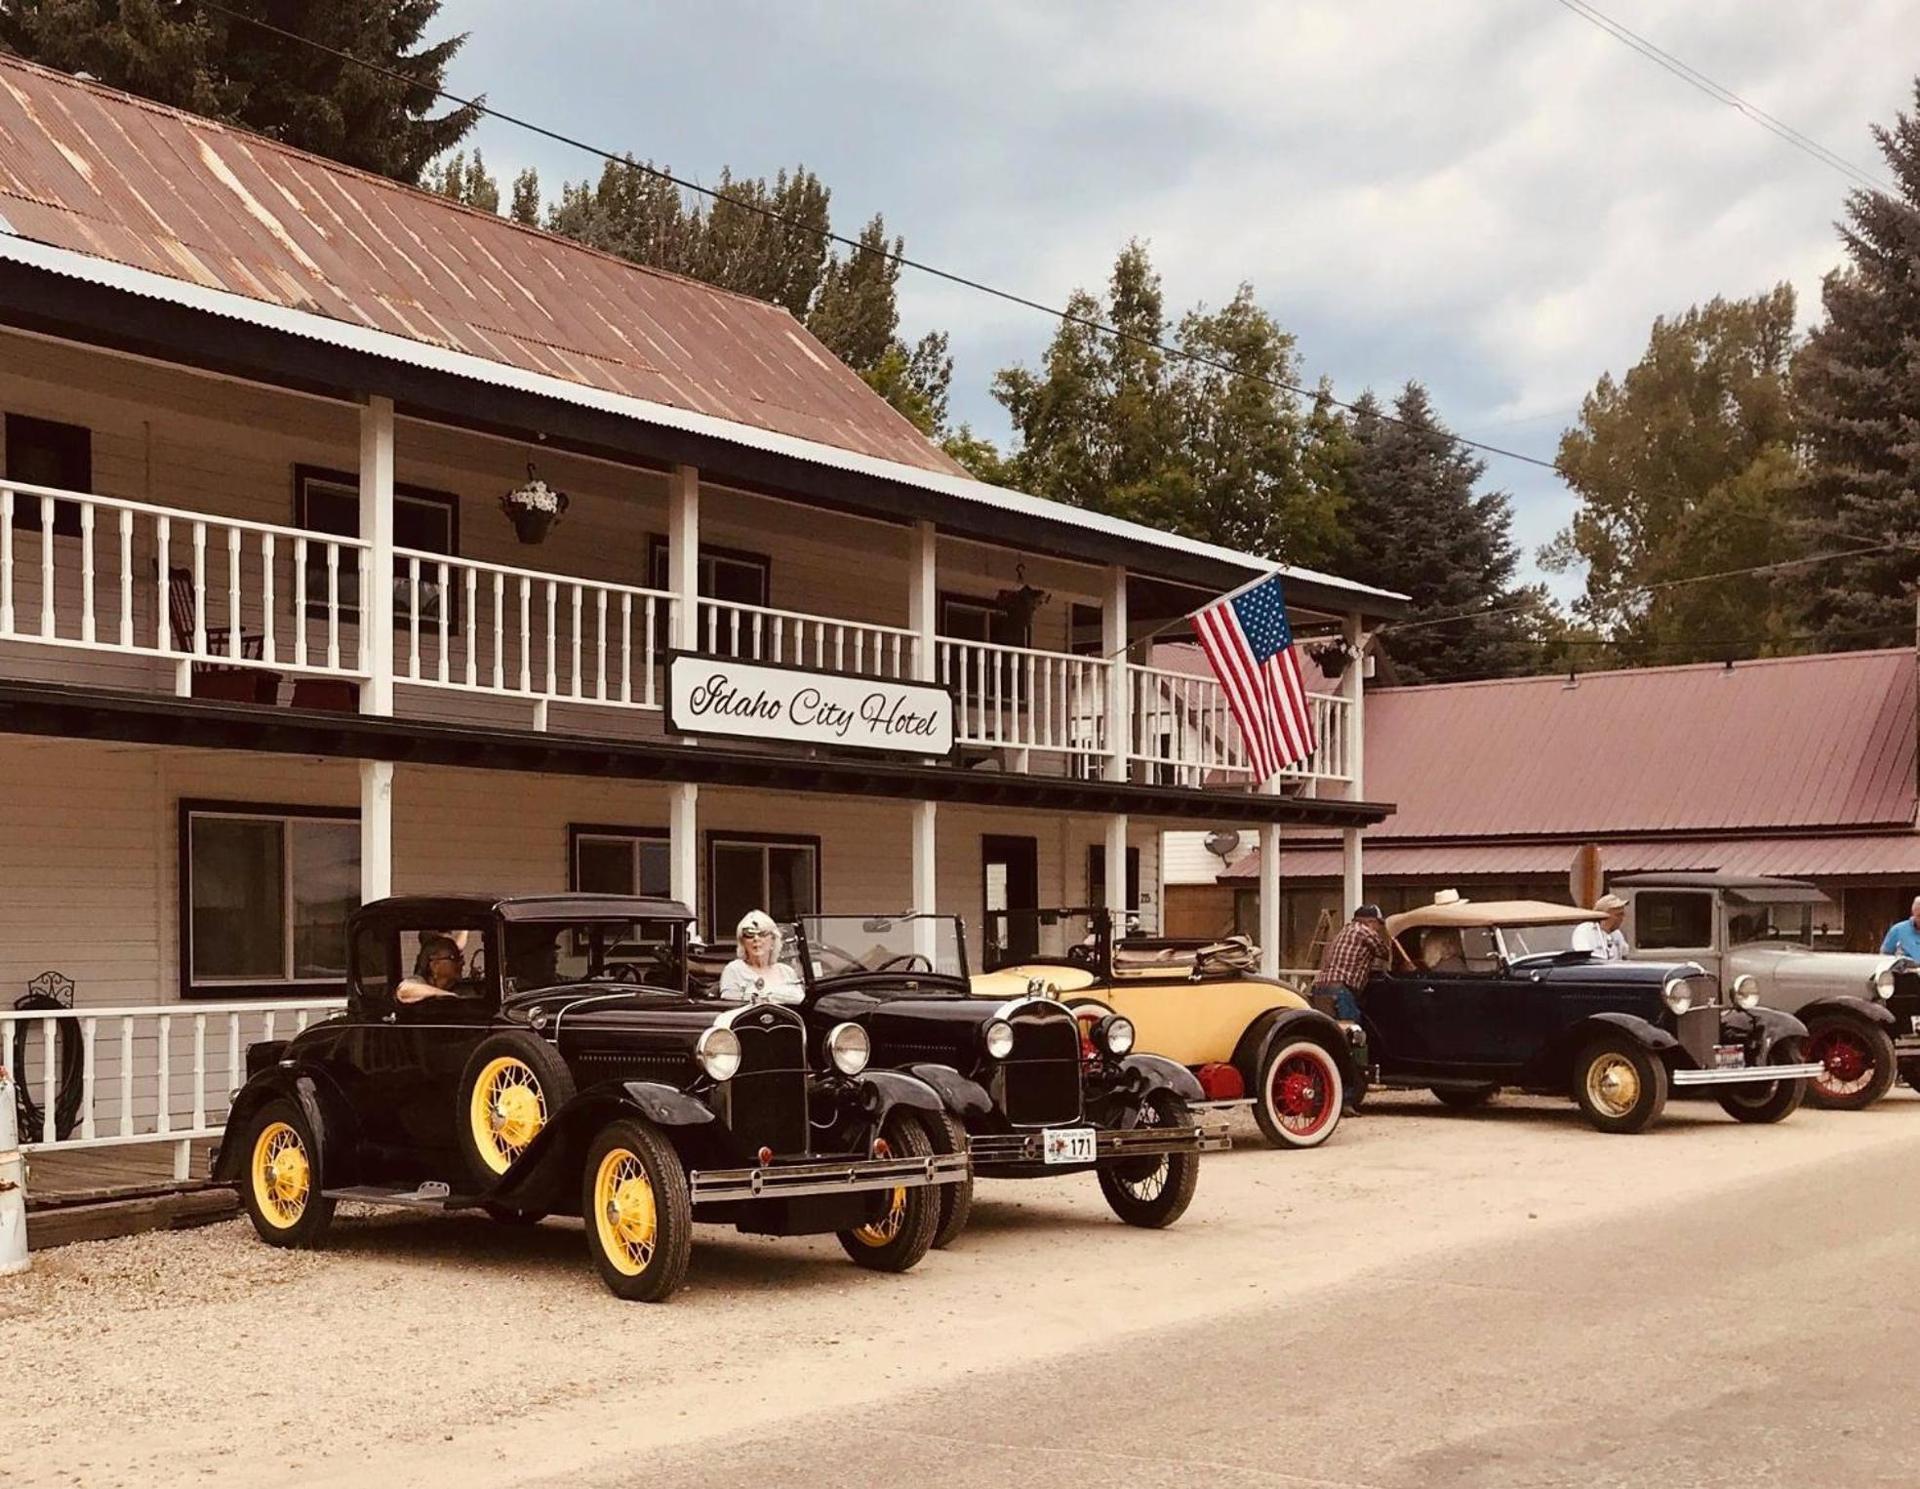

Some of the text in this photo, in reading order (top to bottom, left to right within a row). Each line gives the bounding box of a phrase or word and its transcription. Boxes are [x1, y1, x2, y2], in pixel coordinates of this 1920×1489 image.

[690, 674, 938, 737] Idaho City Hotel
[1071, 1138, 1091, 1156] 171
